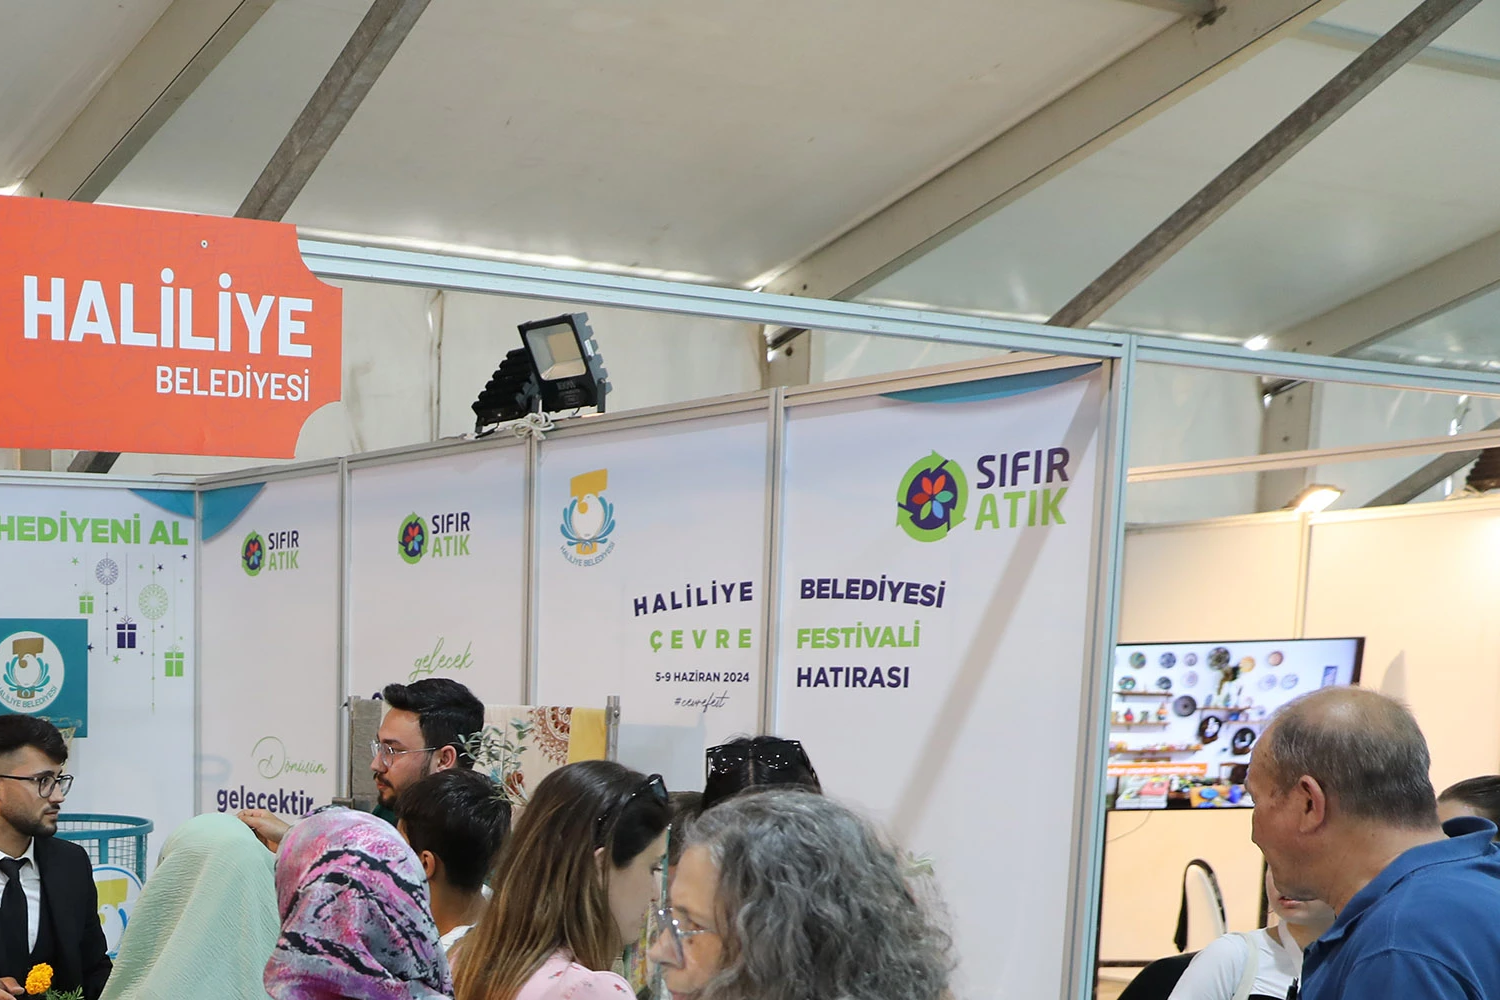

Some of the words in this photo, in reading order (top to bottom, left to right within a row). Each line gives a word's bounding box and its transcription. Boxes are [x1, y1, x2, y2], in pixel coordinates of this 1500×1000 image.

[23, 267, 313, 358] HALİLİYE
[156, 364, 310, 402] BELEDİYESİ
[977, 446, 1070, 490] SIFIR
[432, 512, 471, 534] SIFIR
[975, 486, 1068, 532] ATIK
[148, 520, 189, 546] AL
[267, 530, 299, 551] SIFIR
[432, 534, 471, 558] ATIK
[268, 550, 299, 571] ATIK
[633, 580, 753, 616] HALİLİYE
[800, 574, 946, 609] BELEDİYESİ
[649, 629, 752, 652] ÇEVRE
[797, 621, 920, 649] FESTİVALİ
[409, 637, 474, 682] gelecek
[655, 672, 671, 682] 5-9
[674, 669, 721, 682] HAZİRAN
[723, 672, 750, 682] 2024
[796, 666, 910, 688] HATIRASI
